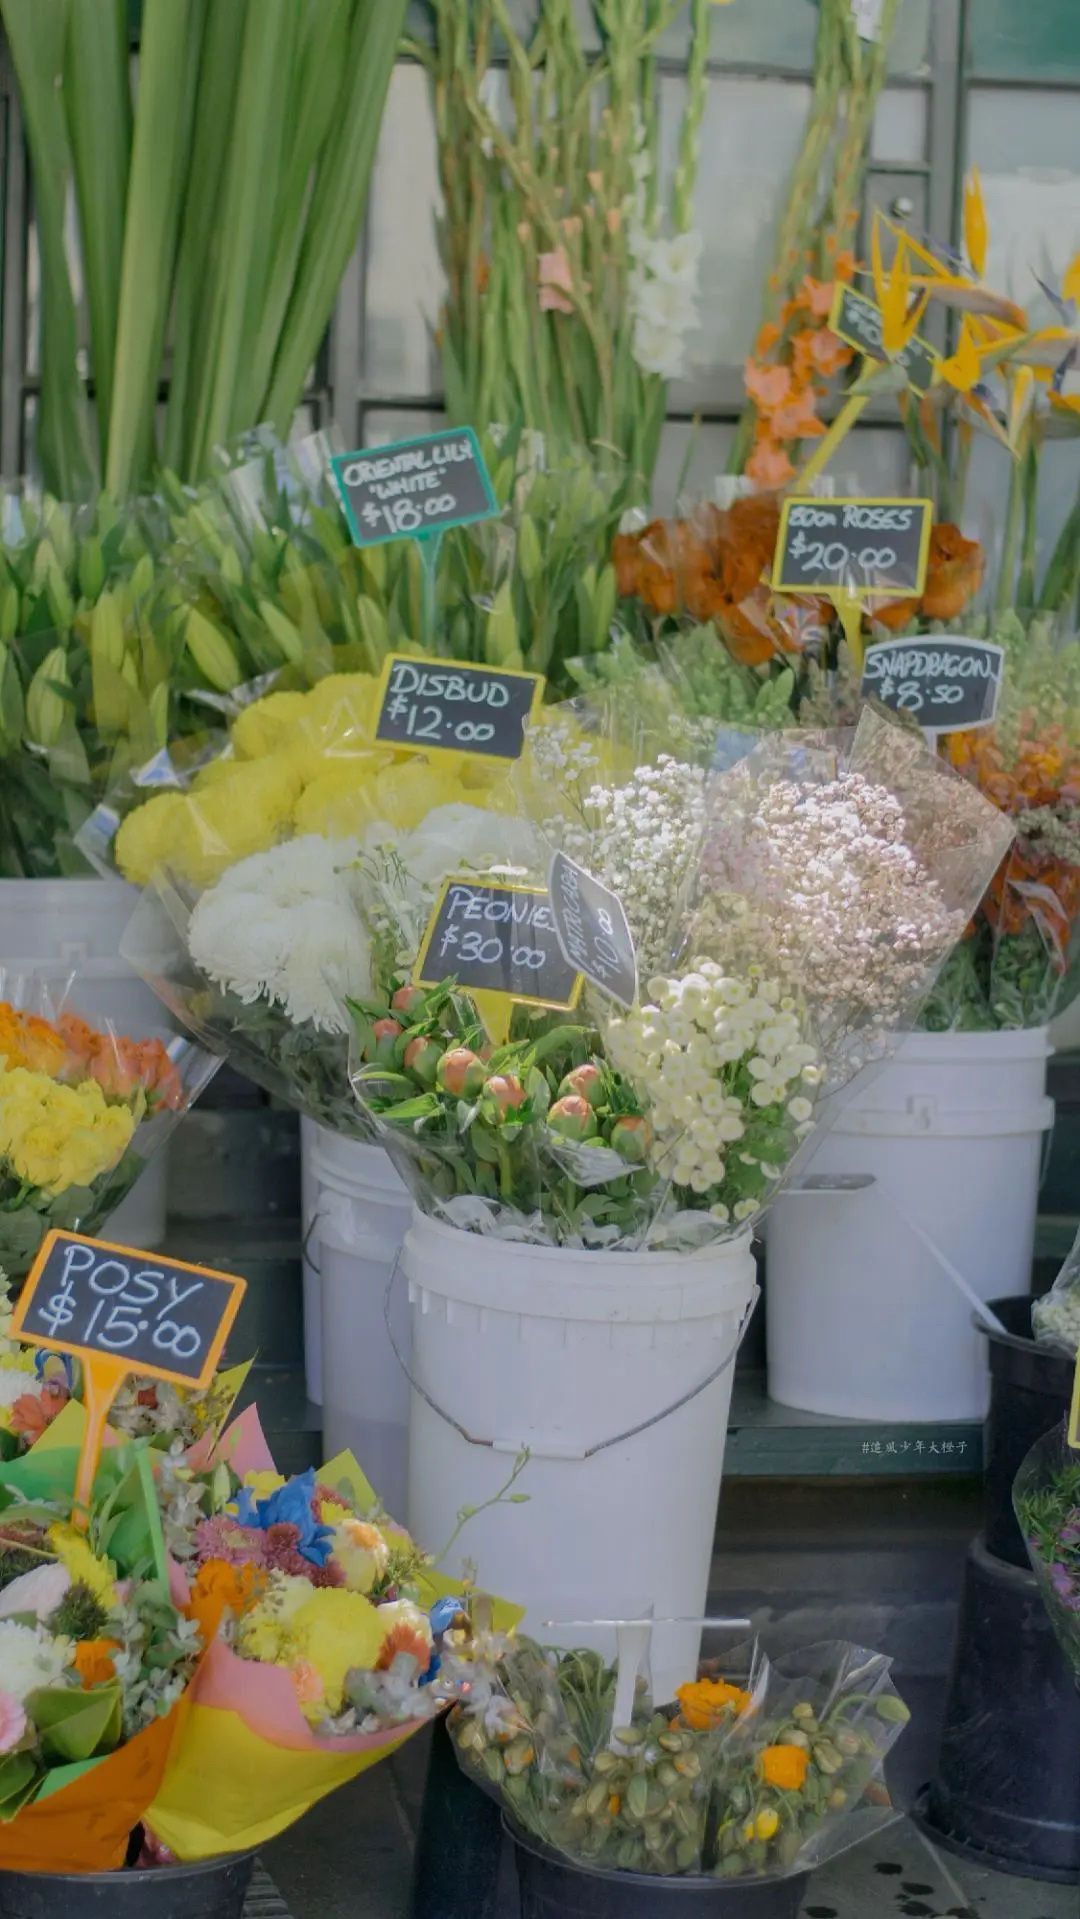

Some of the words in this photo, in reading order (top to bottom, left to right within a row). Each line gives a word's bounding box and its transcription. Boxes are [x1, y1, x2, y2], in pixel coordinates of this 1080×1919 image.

[431, 439, 474, 465] LILY
[863, 650, 993, 679] SNAPDRAGON
[390, 663, 509, 707] DISBUD
[60, 1244, 204, 1321] POSY
